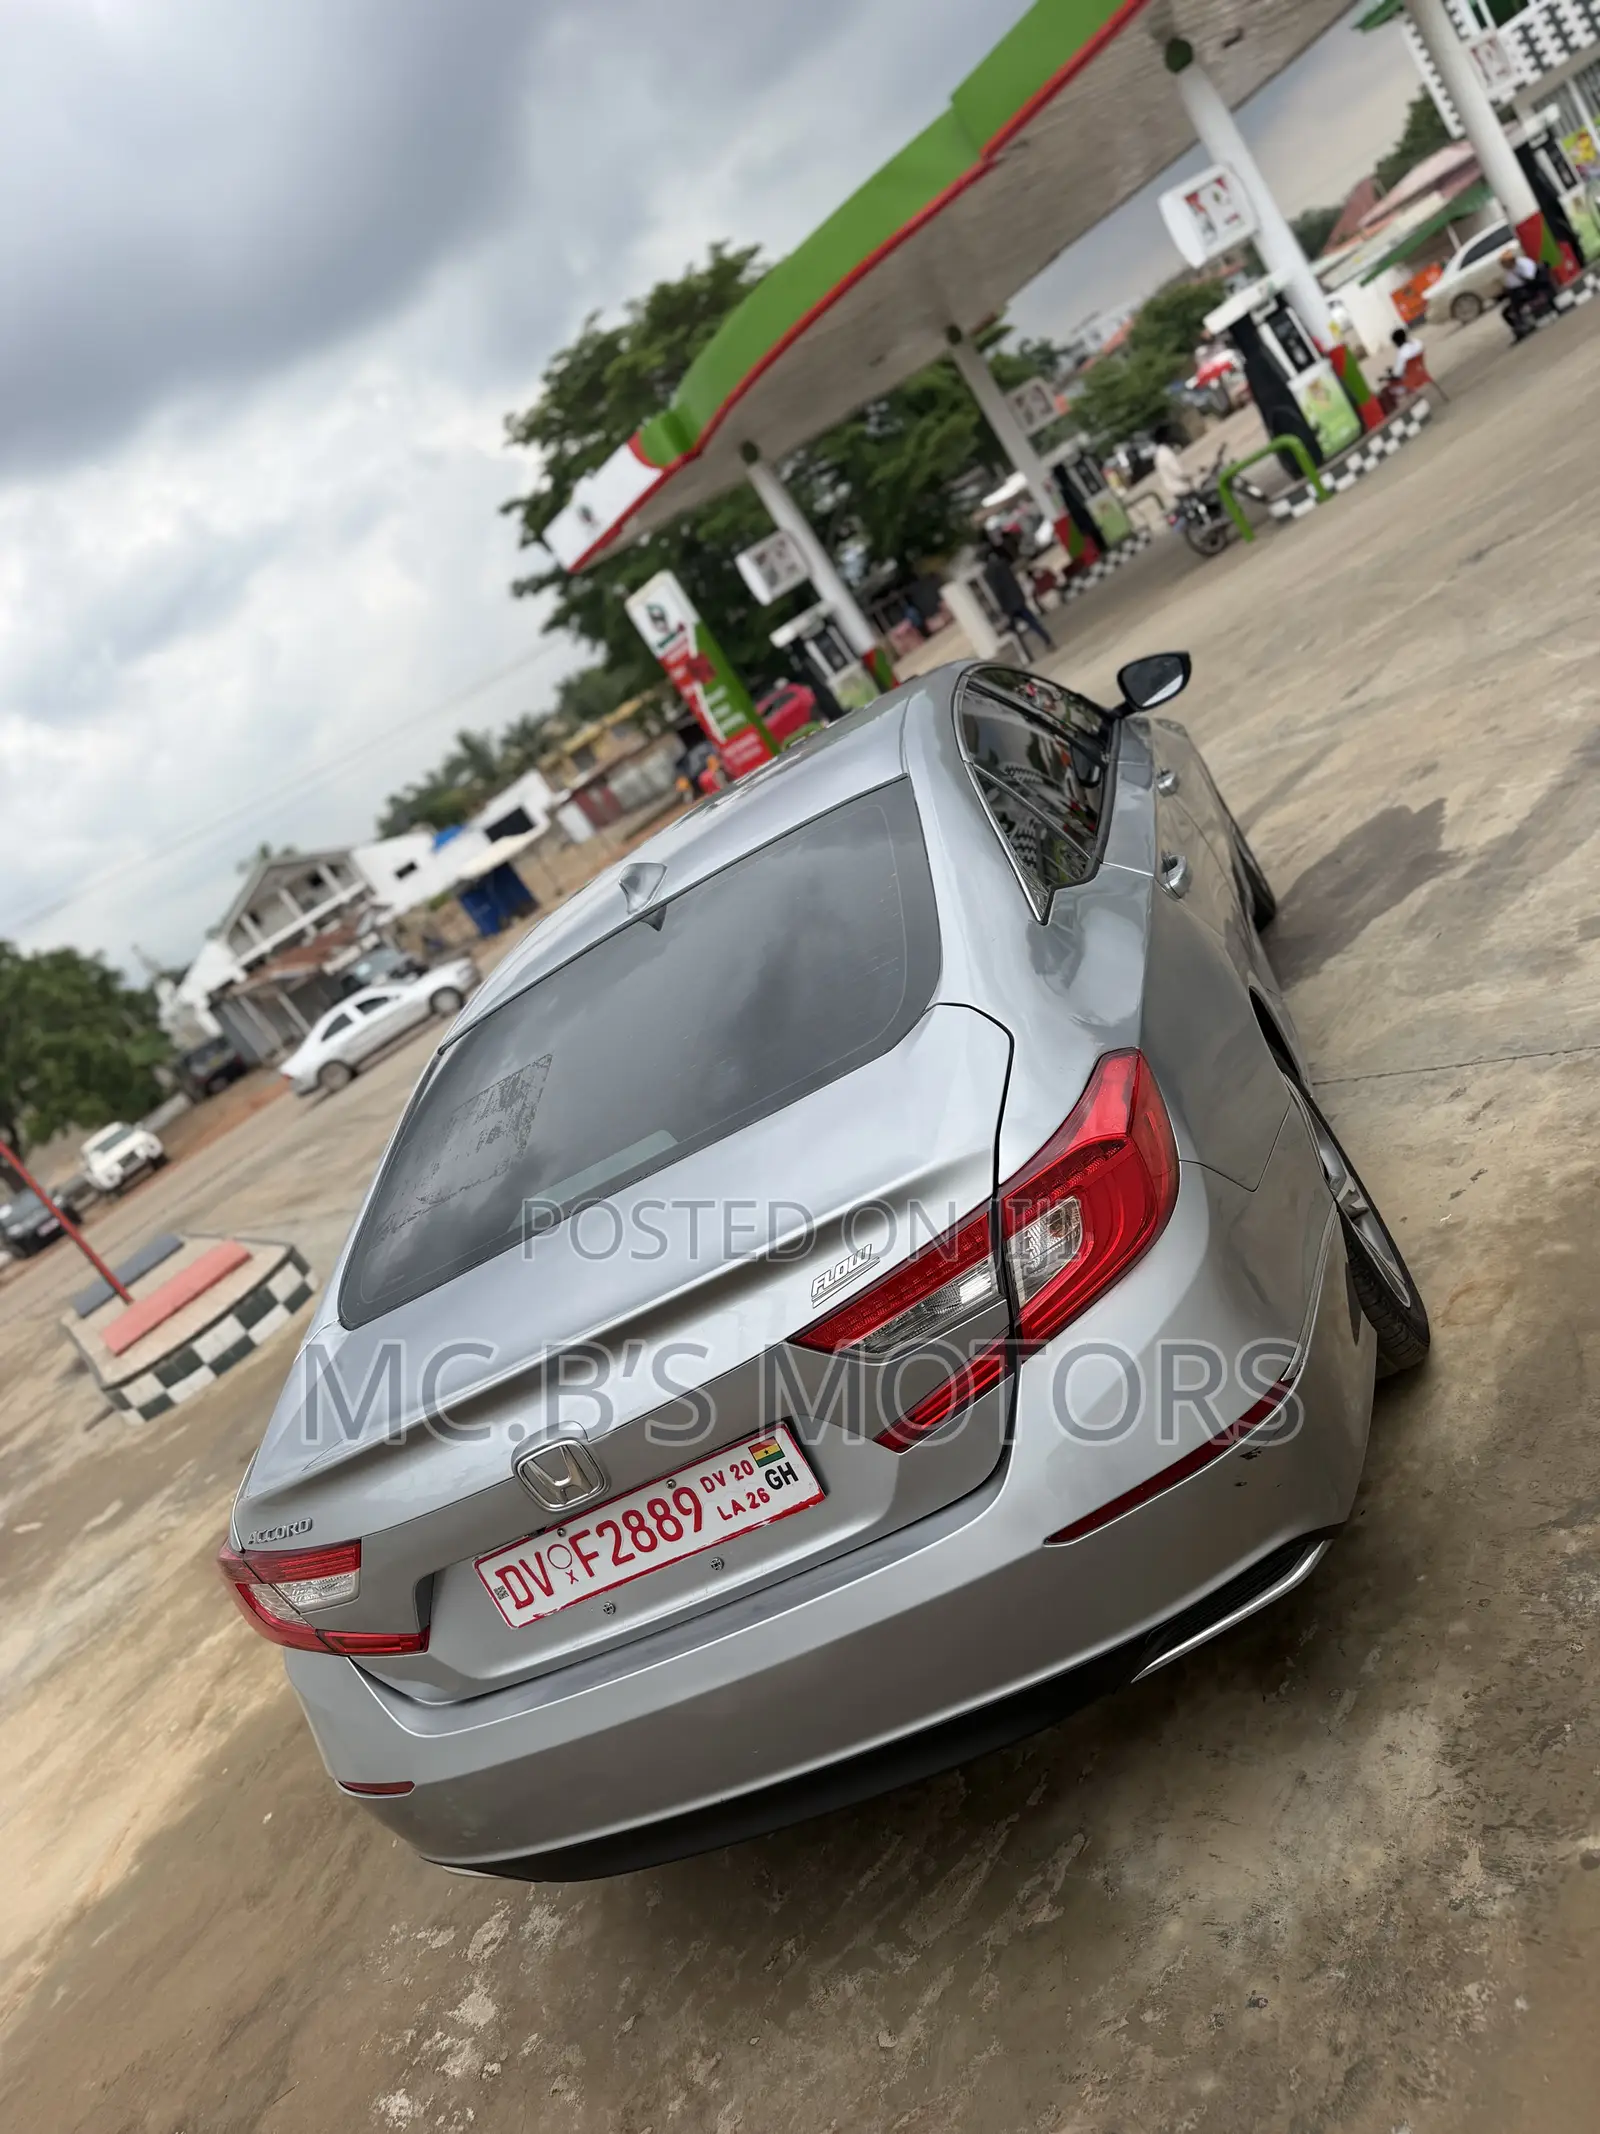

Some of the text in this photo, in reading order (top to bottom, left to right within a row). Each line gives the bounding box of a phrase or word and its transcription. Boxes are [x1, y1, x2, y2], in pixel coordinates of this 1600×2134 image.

[811, 1243, 872, 1298] FLOW
[699, 1459, 754, 1493] DV 20
[764, 1461, 799, 1490] GH
[716, 1487, 770, 1521] LA 26
[247, 1517, 313, 1545] ACCORD
[495, 1486, 704, 1609] DV F2889
